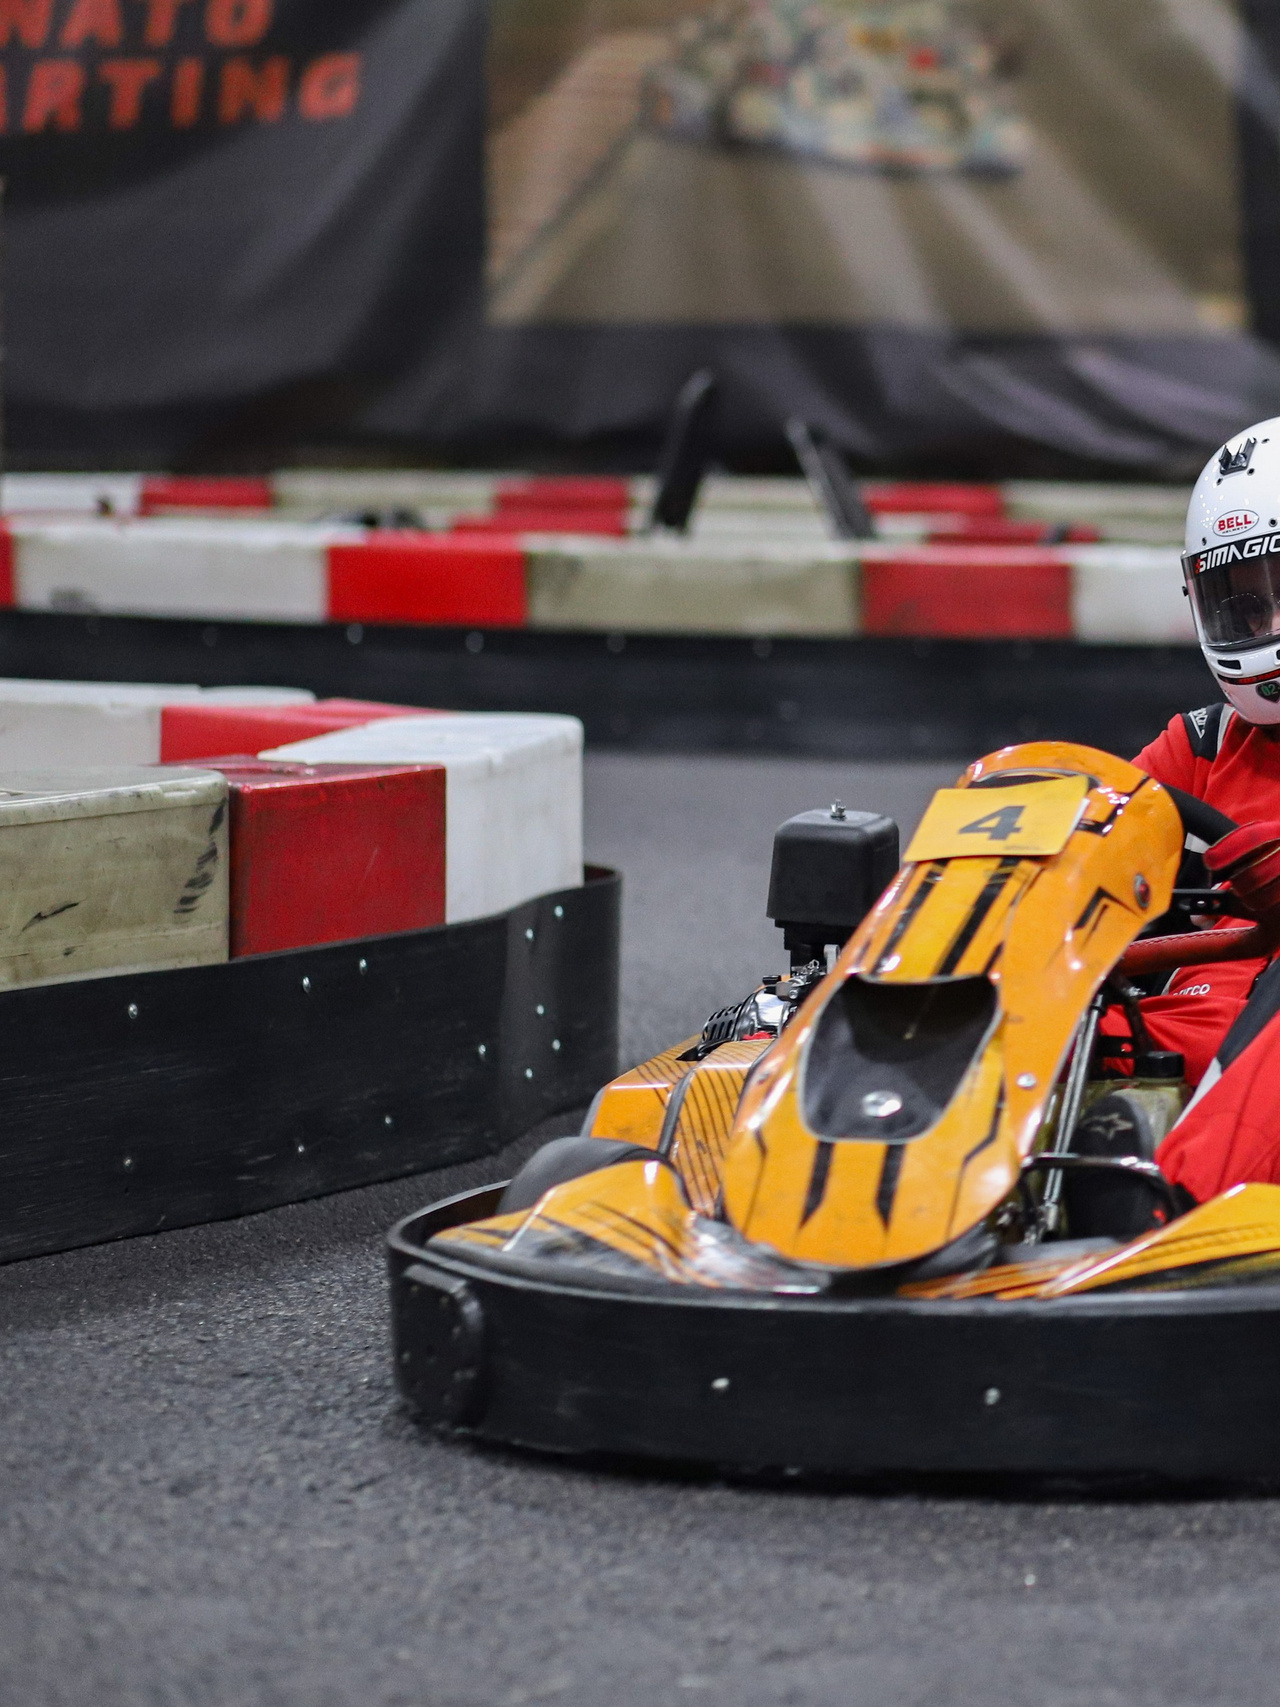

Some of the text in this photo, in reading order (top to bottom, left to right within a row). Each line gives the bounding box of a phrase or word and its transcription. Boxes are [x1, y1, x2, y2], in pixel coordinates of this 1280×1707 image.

[0, 54, 361, 134] RTING
[1218, 514, 1252, 531] BELL
[958, 805, 1027, 841] 4
